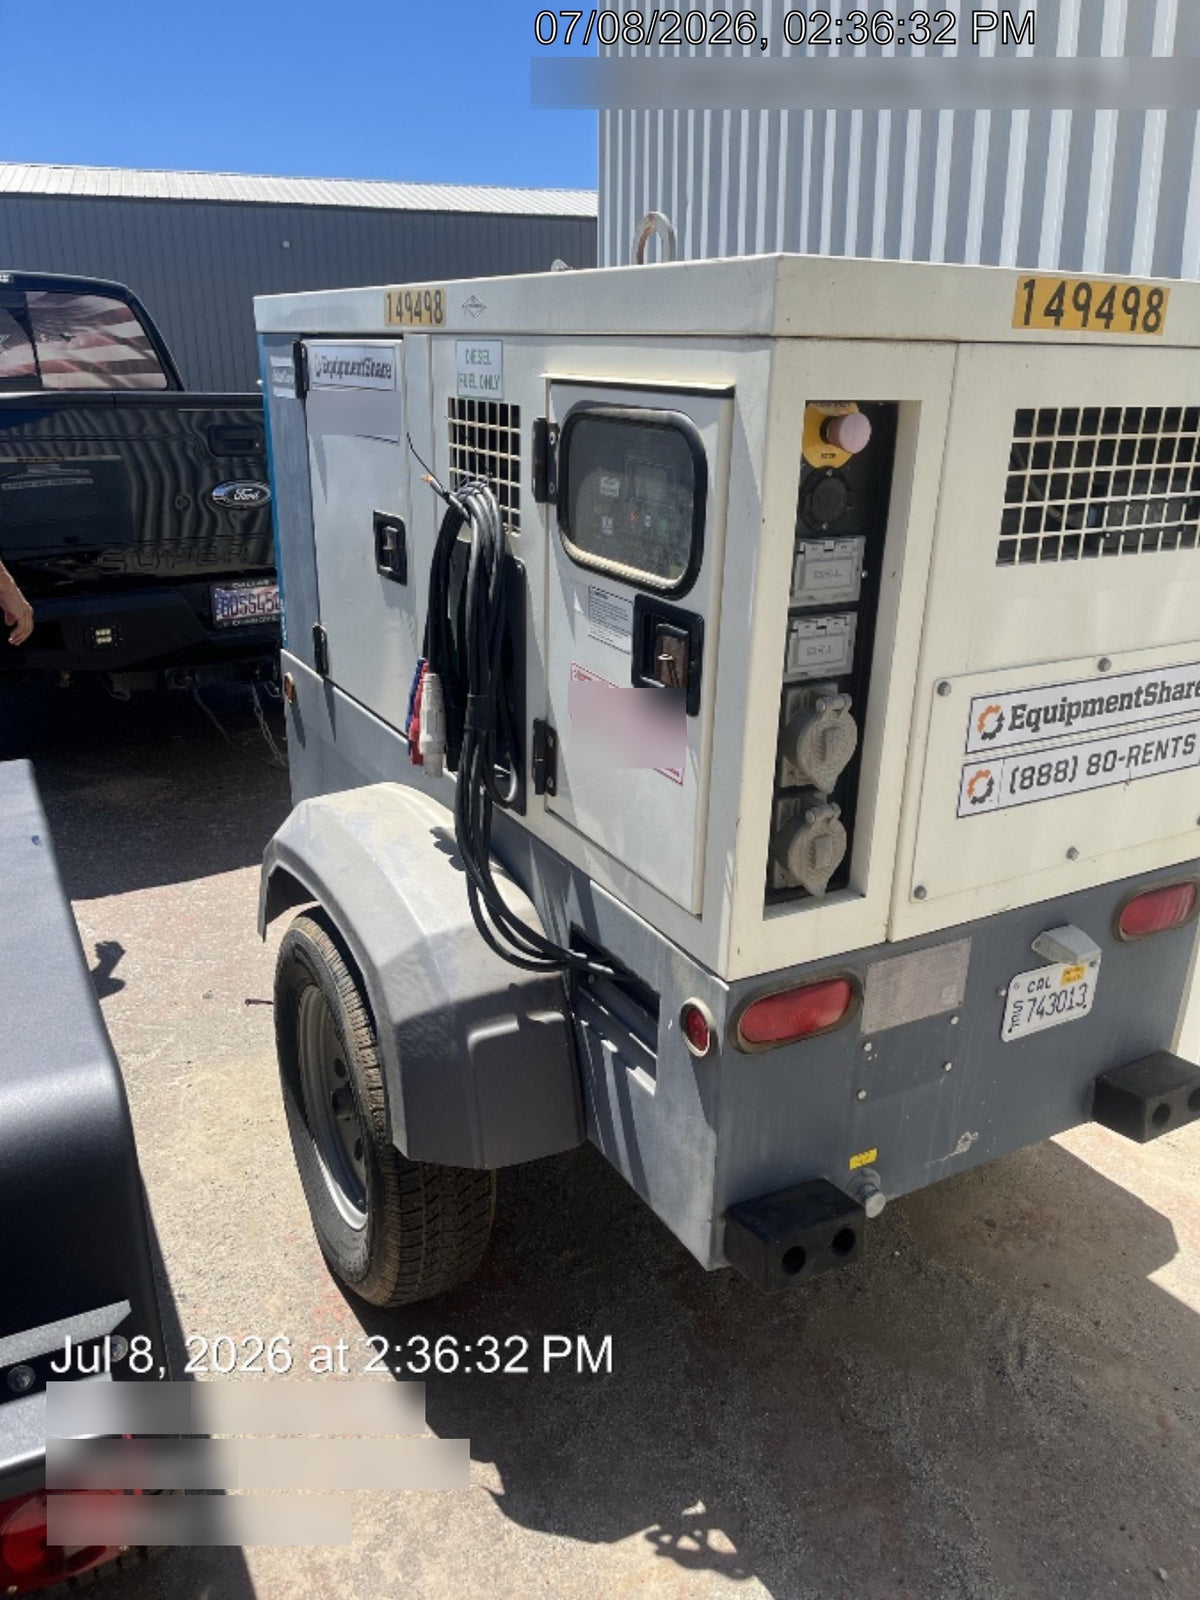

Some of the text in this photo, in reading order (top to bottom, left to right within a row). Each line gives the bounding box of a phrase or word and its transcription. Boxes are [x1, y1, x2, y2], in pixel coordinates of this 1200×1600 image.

[386, 289, 443, 324] 149498
[1023, 278, 1164, 333] 149498
[464, 349, 492, 365] DIESEL
[459, 373, 477, 389] FUEL
[234, 488, 260, 500] Ford
[1009, 733, 1196, 794] (888) 80-RENTS
[1027, 976, 1052, 993] CAL
[1028, 982, 1088, 1023] 743013
